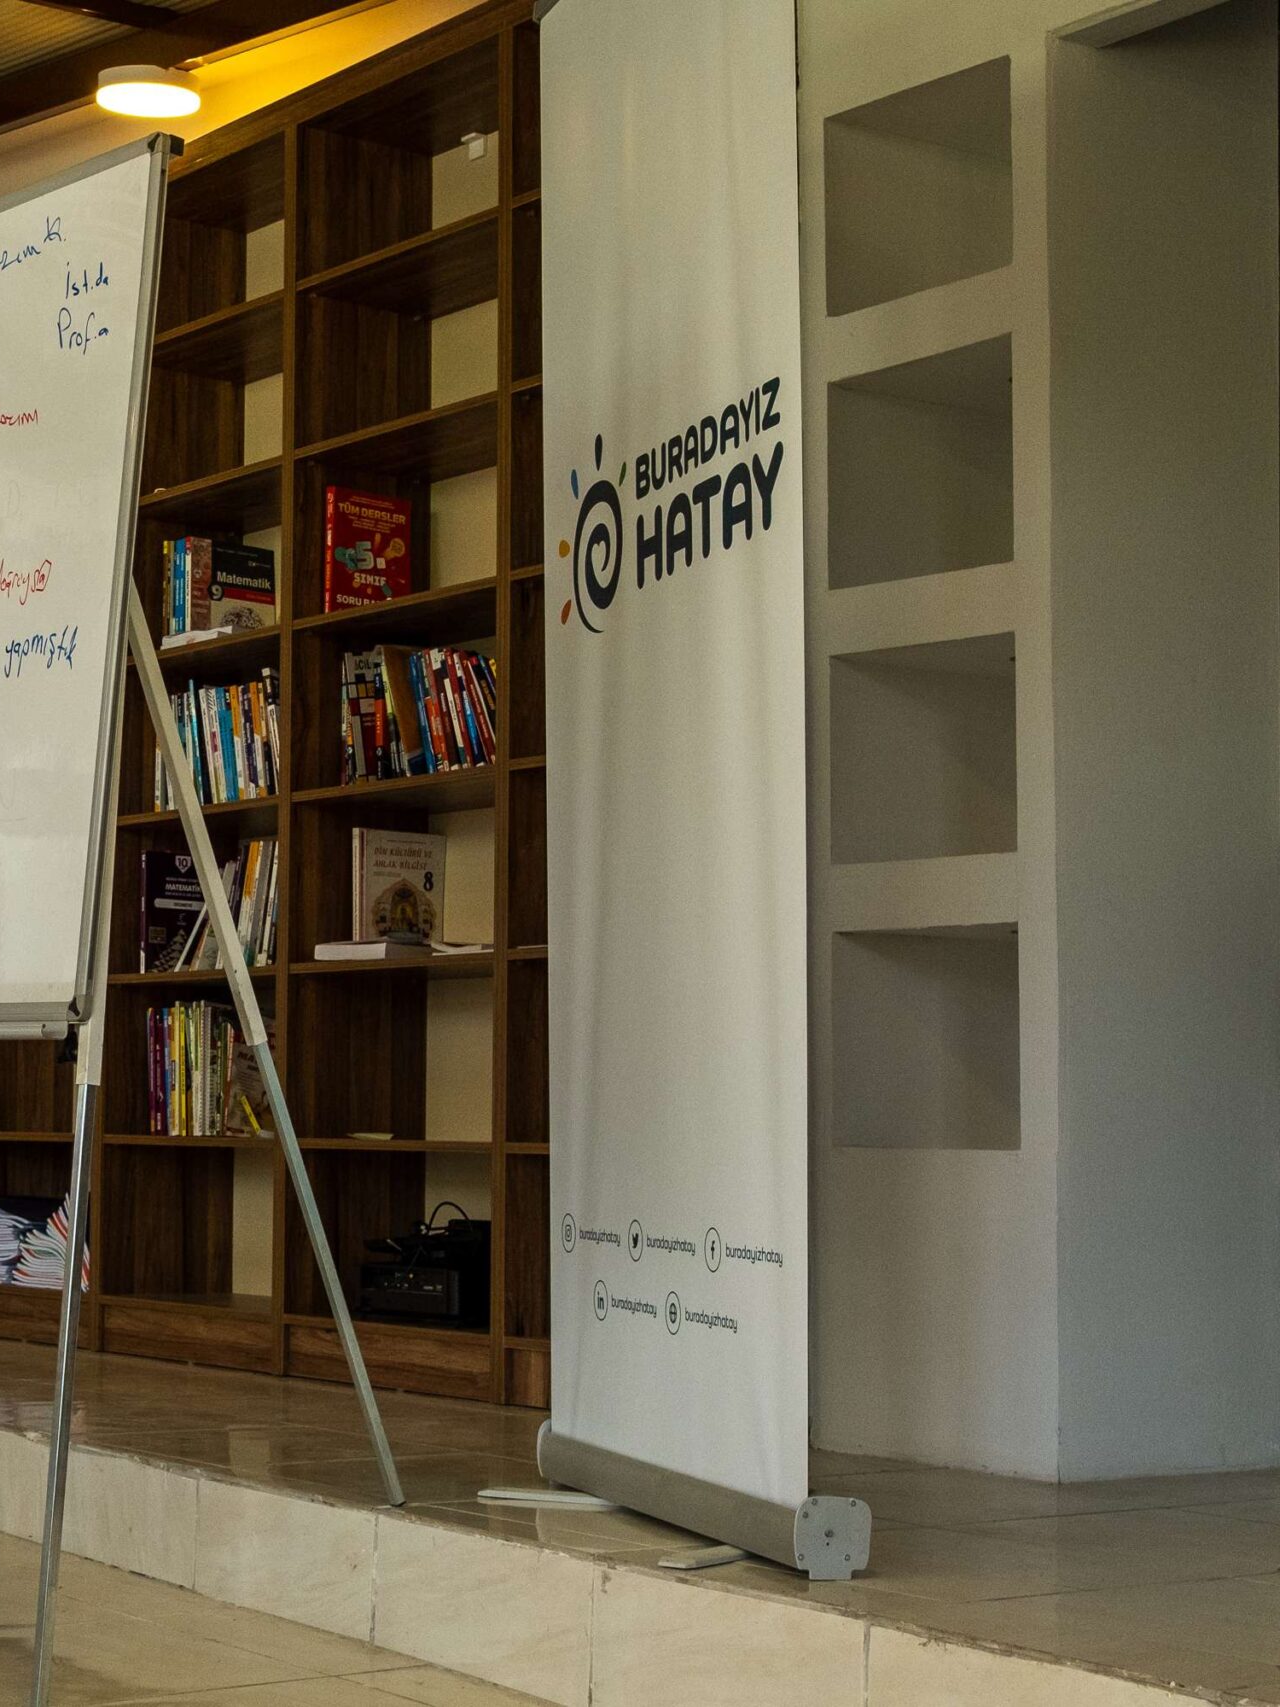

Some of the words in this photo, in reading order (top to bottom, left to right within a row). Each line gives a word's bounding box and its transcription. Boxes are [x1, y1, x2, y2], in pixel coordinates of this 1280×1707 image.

[636, 376, 781, 500] BURADAYIZ
[337, 502, 359, 516] TÜM
[361, 508, 407, 525] DERSLER
[637, 441, 784, 590] HATAY
[217, 570, 271, 591] Matematik
[353, 571, 387, 587] SINIF
[211, 584, 223, 599] 9
[336, 593, 362, 606] SORU
[177, 857, 188, 868] 10
[423, 871, 434, 891] 8
[579, 1227, 620, 1247] buradayizhatay
[646, 1236, 696, 1256] buradayizhatay
[725, 1243, 783, 1268] buradayizhatay
[611, 1295, 657, 1318] buradayizhatay
[685, 1309, 737, 1334] buradayizhatay
